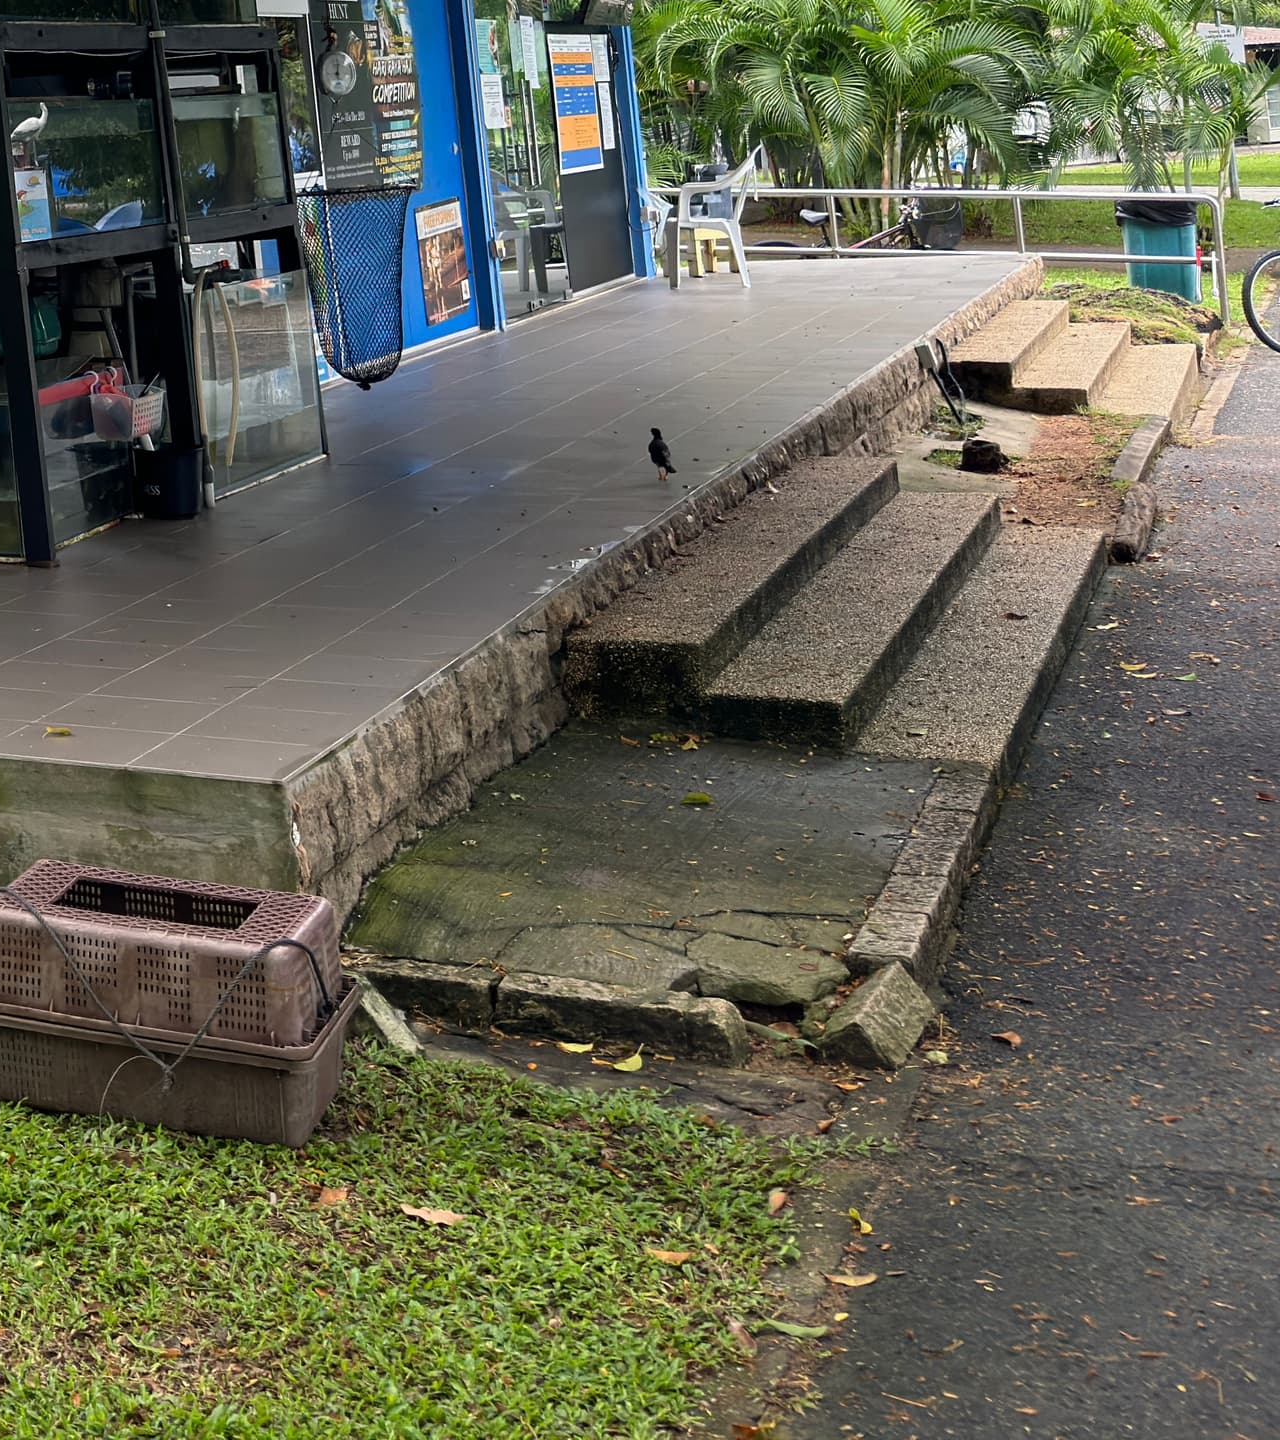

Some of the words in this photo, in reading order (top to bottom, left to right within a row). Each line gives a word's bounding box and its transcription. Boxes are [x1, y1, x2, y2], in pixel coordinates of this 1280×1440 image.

[327, 3, 349, 20] HUNT
[372, 81, 416, 104] COMPETITION
[340, 134, 361, 148] REWARD
